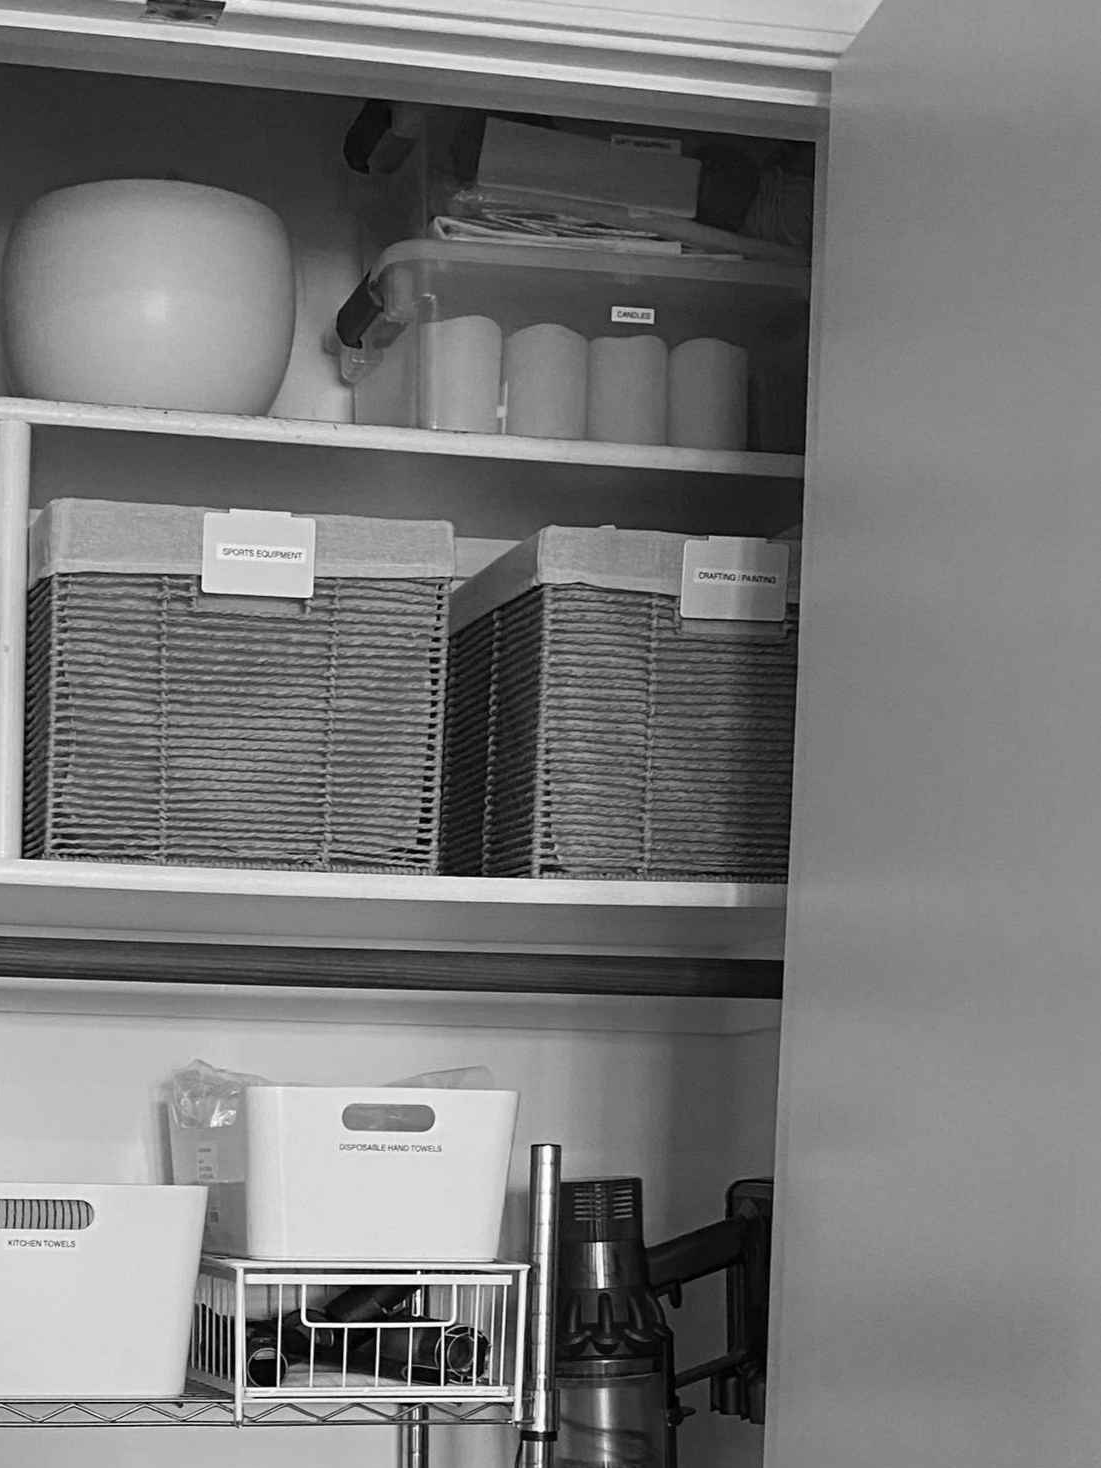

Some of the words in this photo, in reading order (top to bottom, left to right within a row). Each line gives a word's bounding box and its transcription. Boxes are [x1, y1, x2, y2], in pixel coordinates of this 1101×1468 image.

[616, 310, 652, 320] CANDLES
[222, 547, 255, 558] SPORTS
[256, 549, 303, 560] EQUIPMENT
[698, 571, 736, 582] CRAFTING
[741, 574, 777, 585] PAINTING
[339, 1143, 386, 1153] DISPOSABLE
[387, 1144, 409, 1153] HAND
[410, 1145, 442, 1154] TOWELS
[7, 1239, 42, 1248] KITCHEN
[43, 1240, 76, 1249] TOWELS
